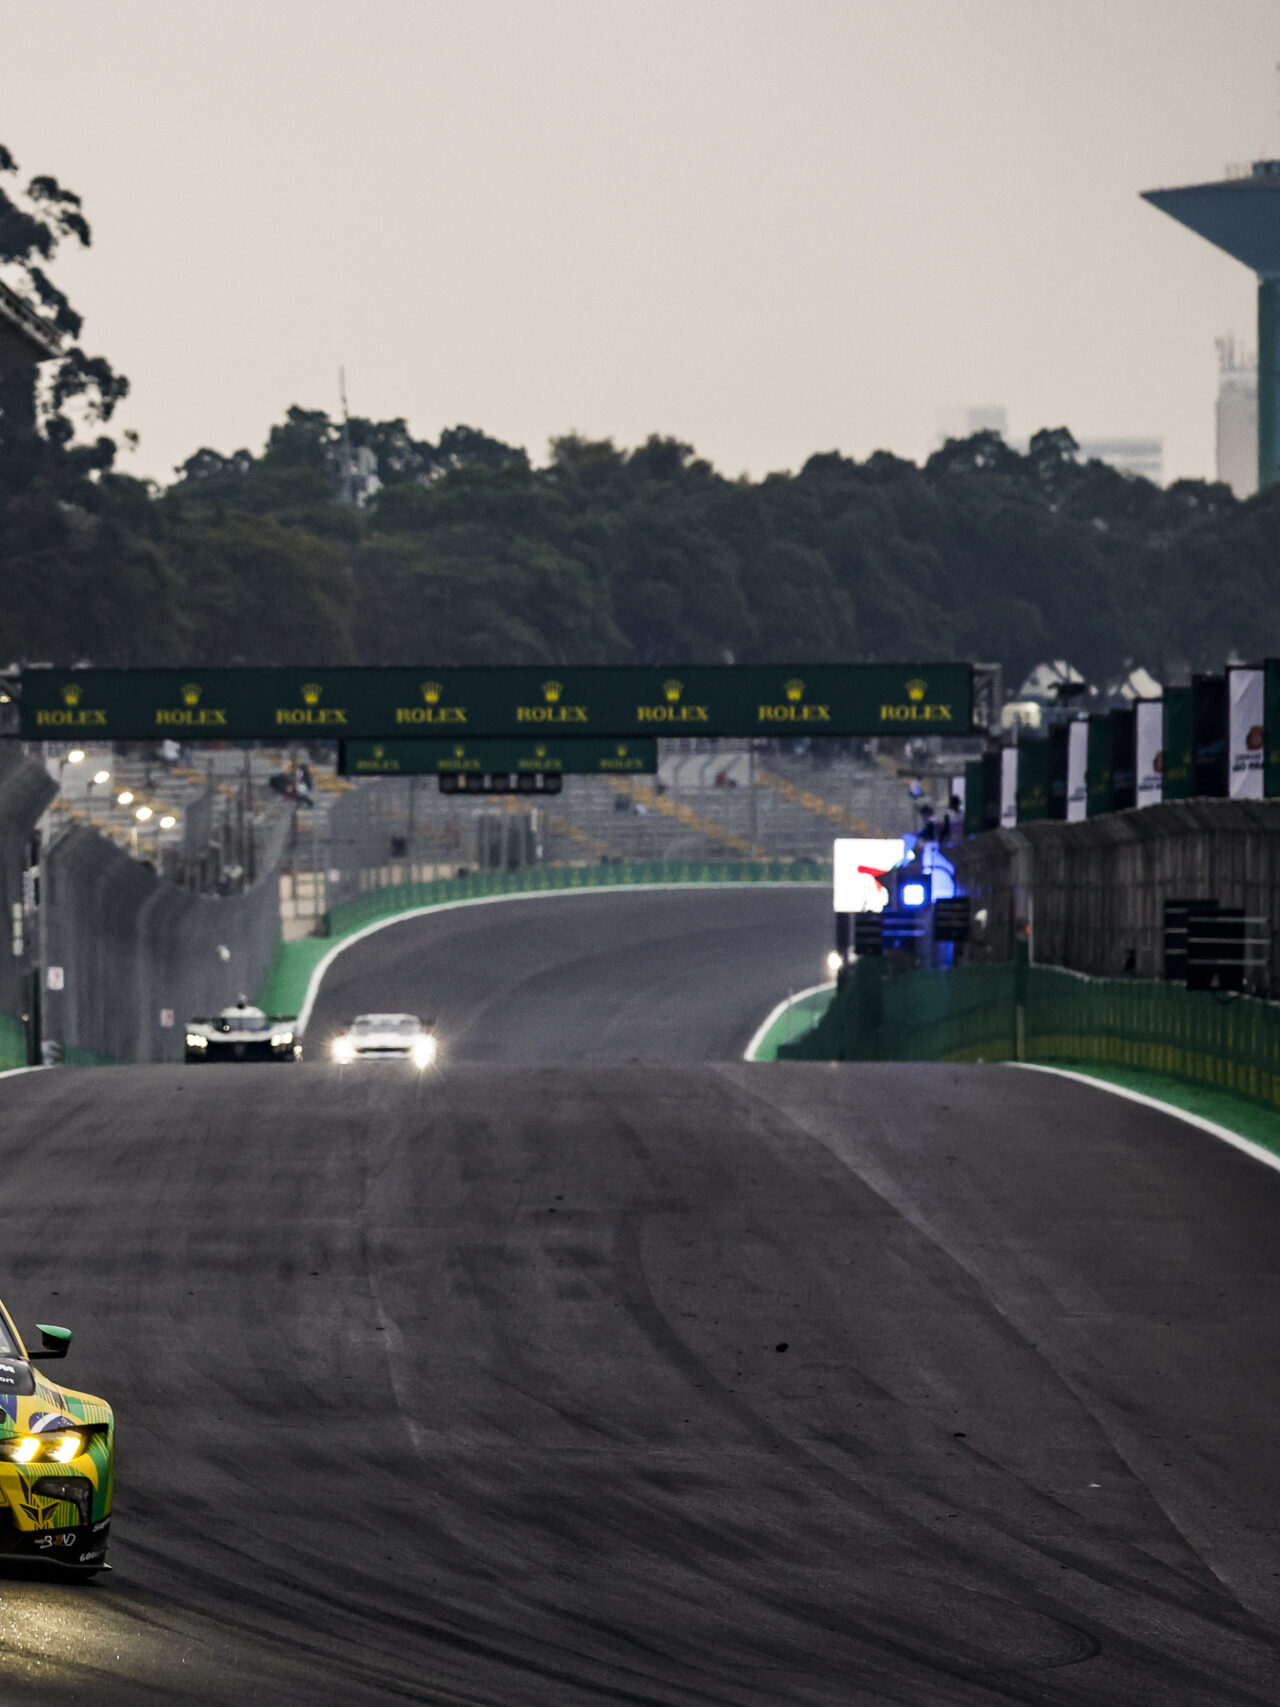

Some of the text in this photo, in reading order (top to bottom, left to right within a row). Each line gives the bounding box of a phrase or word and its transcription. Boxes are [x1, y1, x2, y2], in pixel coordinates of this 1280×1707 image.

[36, 709, 107, 725] ROLEX
[156, 709, 227, 725] ROLEX
[276, 708, 348, 724] ROLEX
[396, 707, 468, 723] ROLEX
[516, 706, 588, 722] ROLEX
[637, 706, 709, 722] ROLEX
[759, 705, 831, 721] ROLEX
[880, 704, 952, 721] ROLEX
